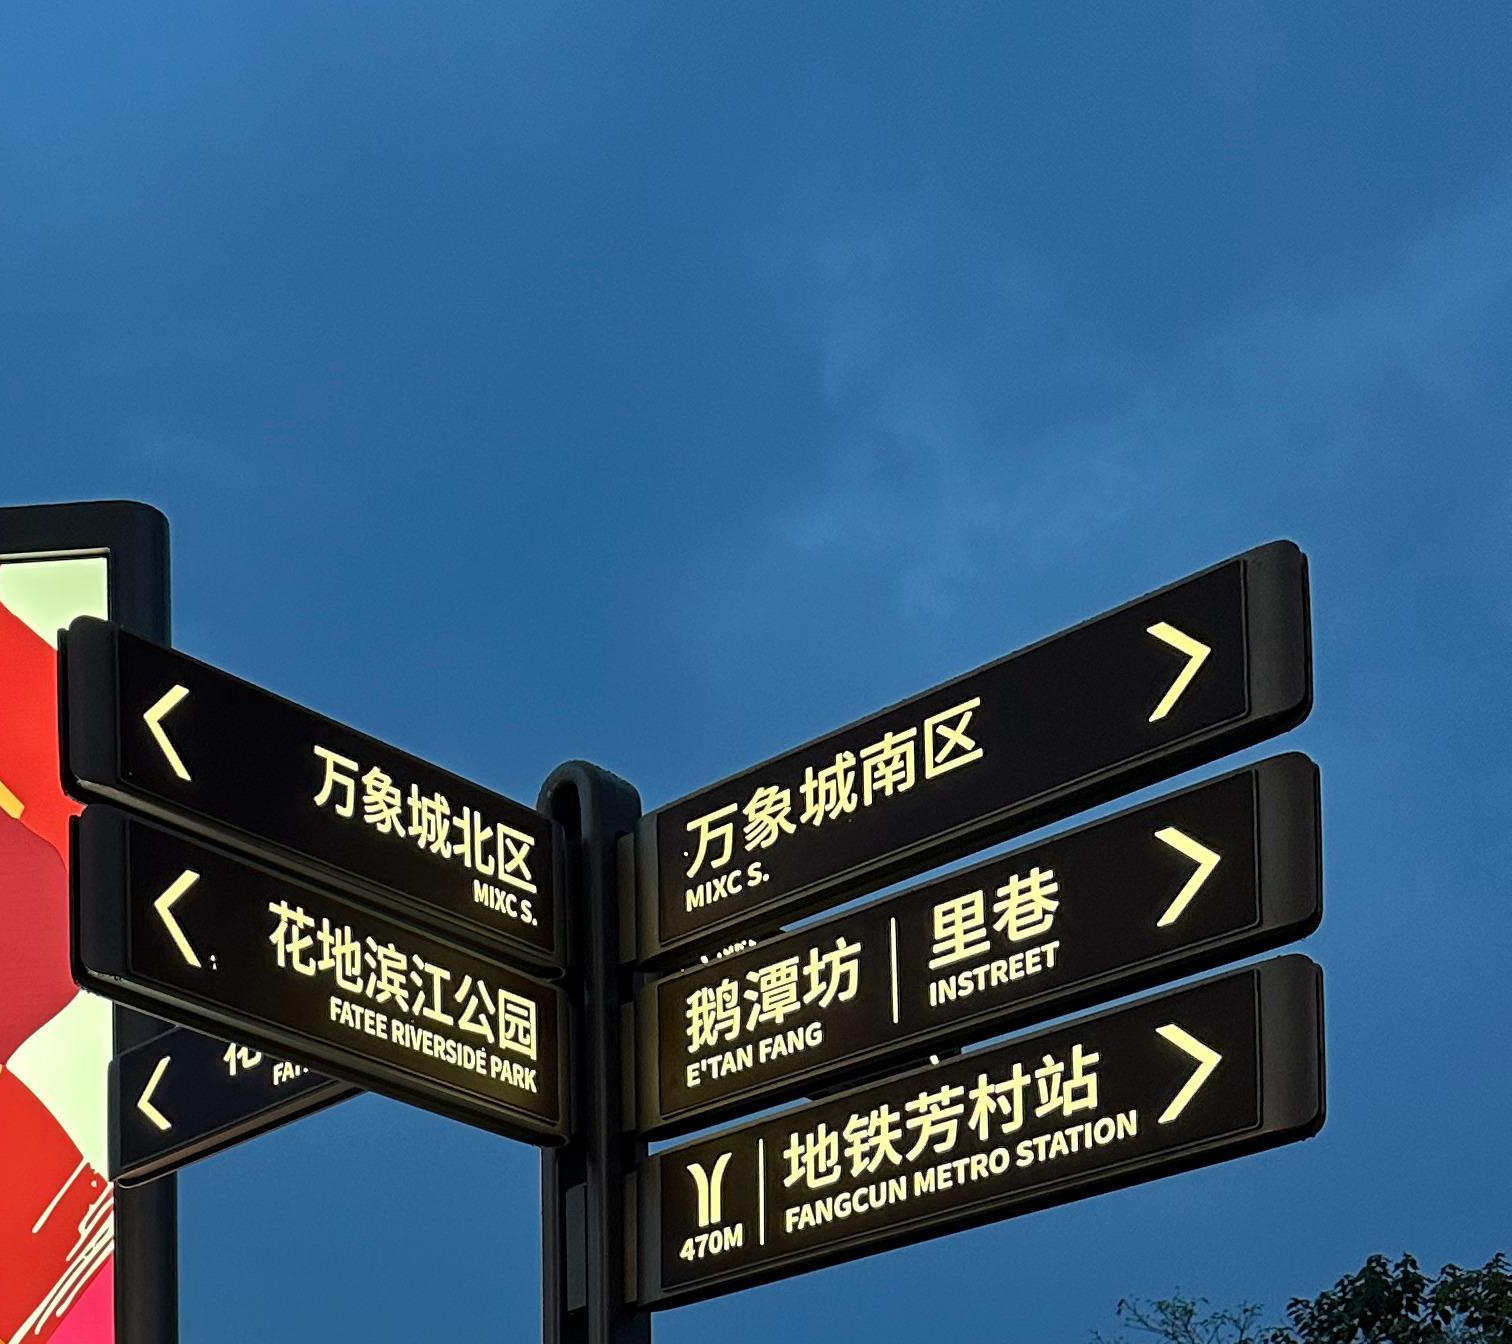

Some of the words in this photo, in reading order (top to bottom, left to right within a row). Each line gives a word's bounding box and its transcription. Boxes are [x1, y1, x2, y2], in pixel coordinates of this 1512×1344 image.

[314, 745, 537, 892] 万象城北区
[685, 697, 984, 878] 万象城南区
[473, 879, 518, 918] MIXC
[520, 899, 538, 926] S.
[685, 869, 743, 912] MIXC
[747, 861, 770, 886] S.
[928, 867, 1060, 971] 里巷
[269, 900, 537, 1061] 花地滨江公园
[685, 936, 862, 1054] 鹅潭坊
[929, 940, 1060, 1007] INSTREET
[330, 996, 388, 1040] FATEE
[391, 1018, 487, 1075] RIVERSIDE
[490, 1055, 537, 1094] PARK
[686, 1044, 753, 1088] E'TAN
[758, 1021, 823, 1064] FANG
[784, 1043, 1100, 1189] 地铁芳村站
[785, 1175, 907, 1233] FANGCUN
[913, 1147, 1009, 1197] METRO
[1016, 1109, 1137, 1167] STATION
[679, 1222, 743, 1261] 470M
